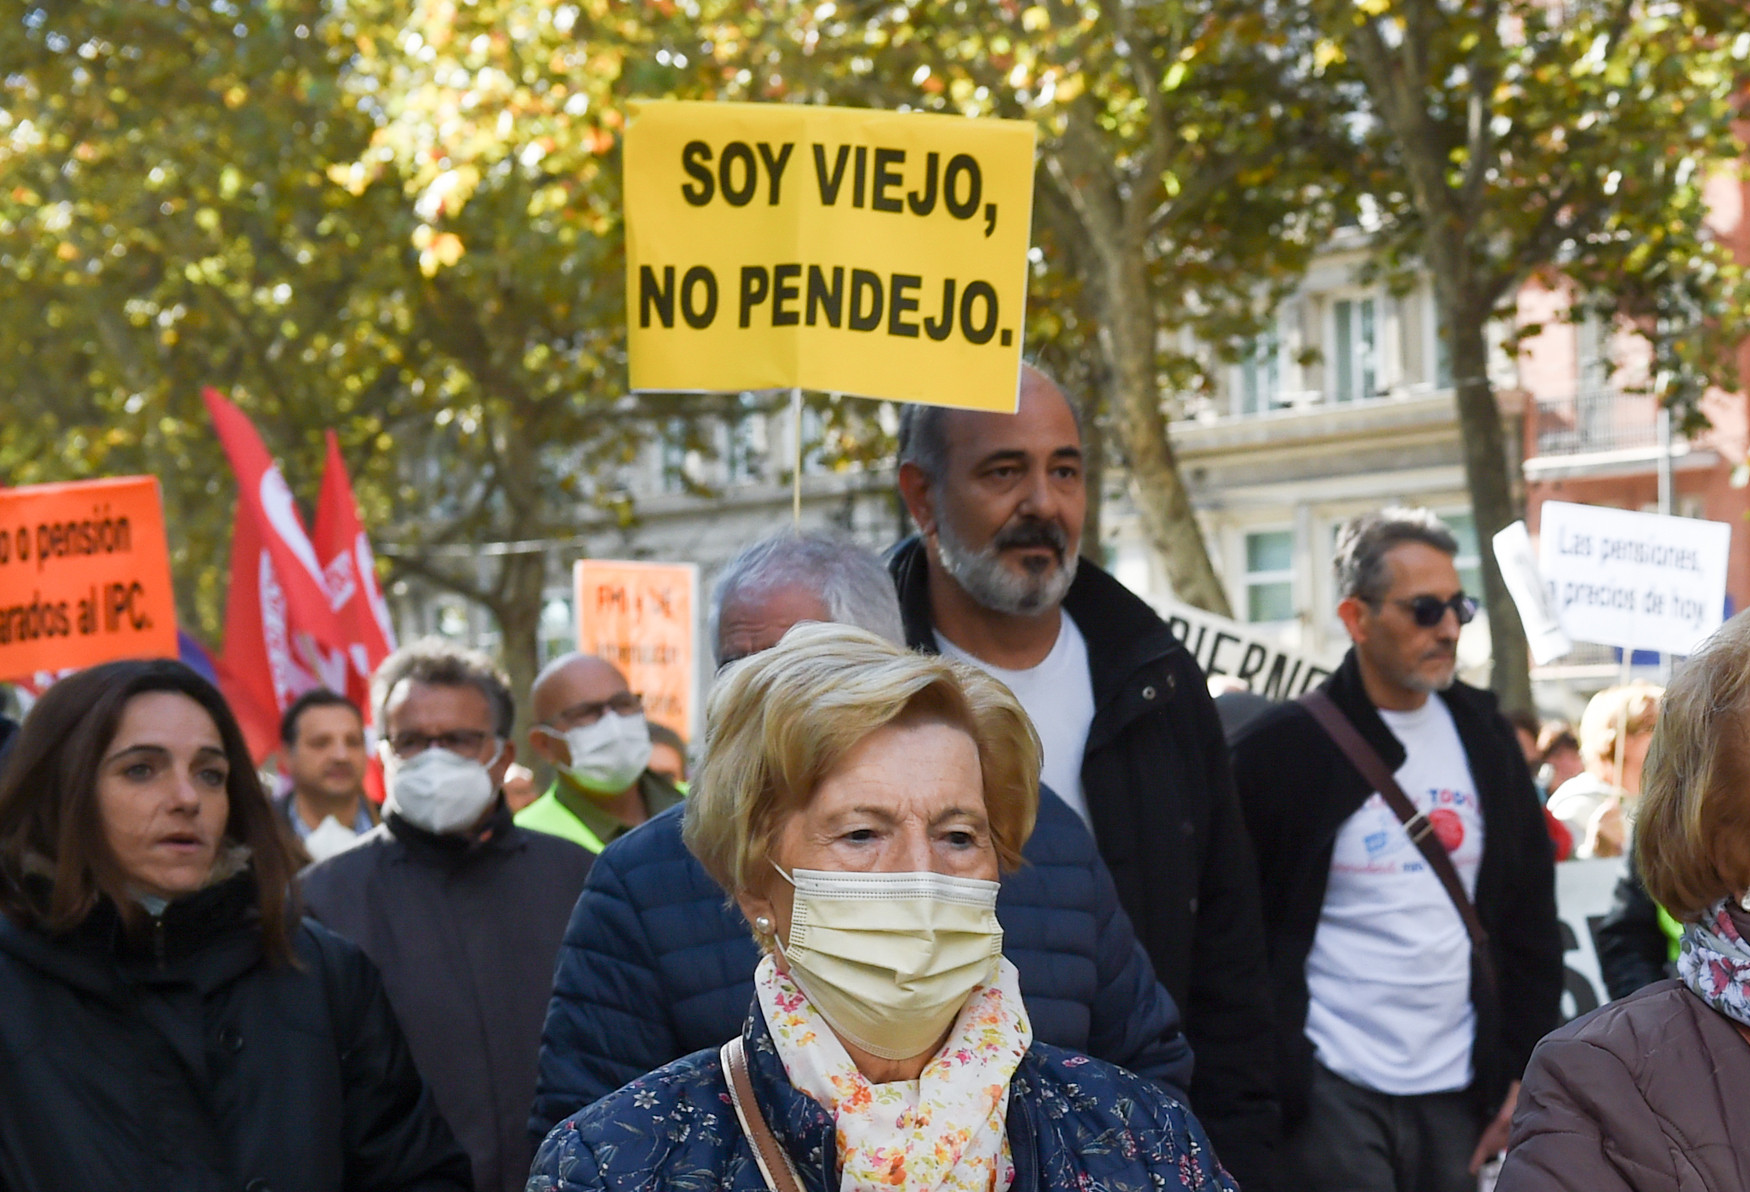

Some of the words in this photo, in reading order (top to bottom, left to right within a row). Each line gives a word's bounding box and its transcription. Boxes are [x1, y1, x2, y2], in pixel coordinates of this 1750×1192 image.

[682, 140, 795, 208] SOY
[812, 143, 998, 238] VIEJO,
[639, 265, 719, 330] NO
[739, 263, 1013, 347] PENDEJO.
[16, 526, 31, 562] o
[37, 503, 133, 573] pensión
[1557, 524, 1592, 557] Las
[78, 584, 98, 635] al
[103, 579, 153, 634] IPC.
[1564, 577, 1636, 611] precios
[1642, 581, 1665, 616] de
